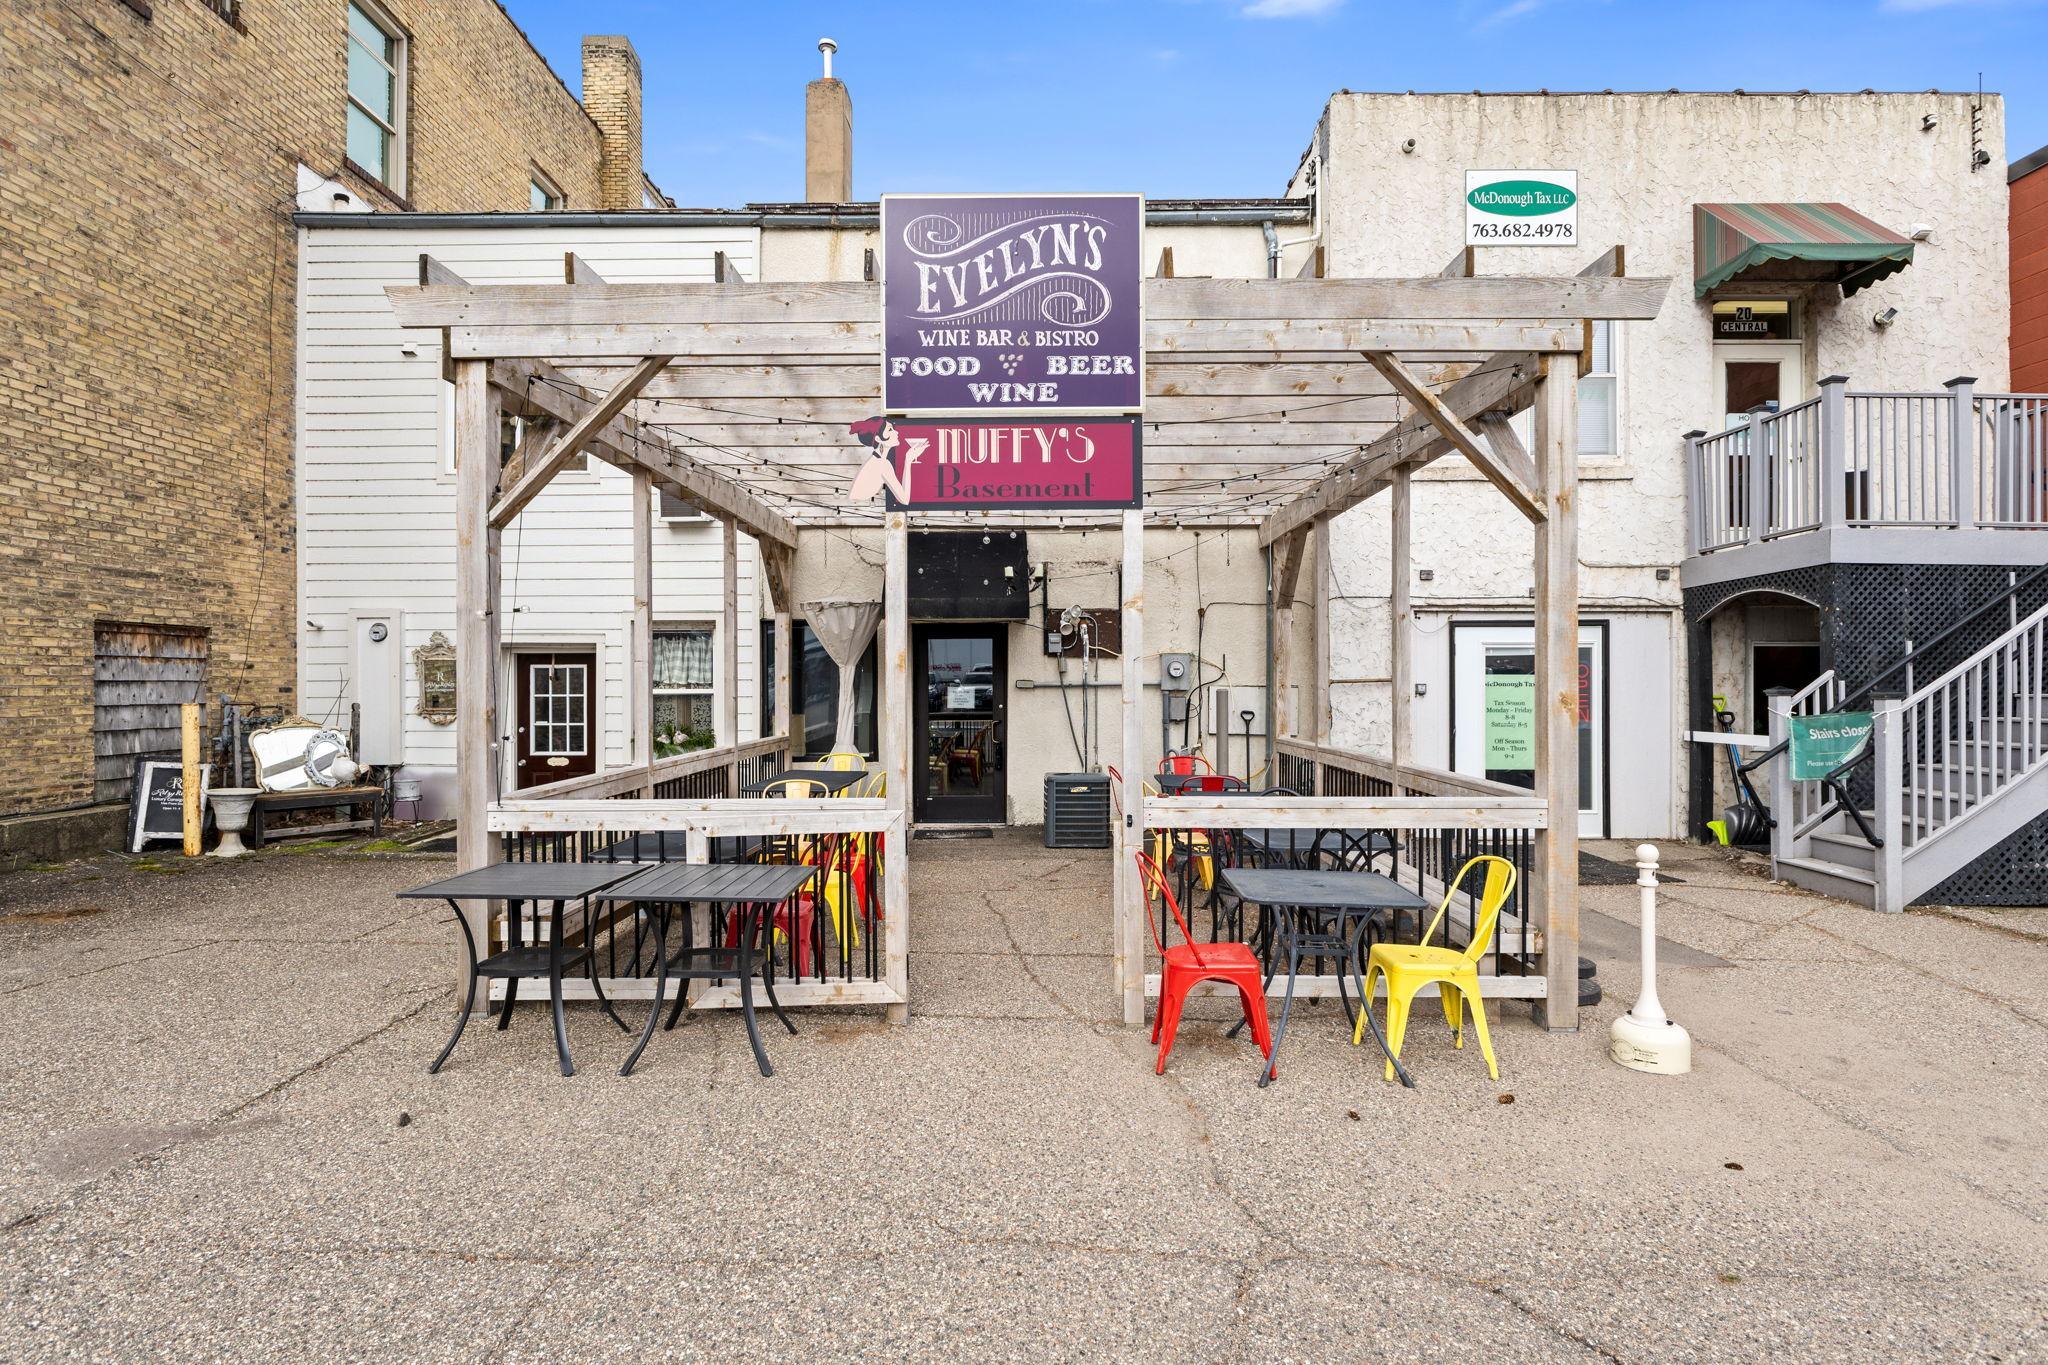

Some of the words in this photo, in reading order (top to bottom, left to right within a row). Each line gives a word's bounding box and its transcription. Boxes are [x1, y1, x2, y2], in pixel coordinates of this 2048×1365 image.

[1474, 191, 1533, 207] McDonough
[1534, 191, 1551, 204] Tax
[1553, 194, 1569, 204] LLC
[1472, 223, 1573, 238] 763.682.4978
[914, 220, 1107, 313] EVELYN'S
[1736, 307, 1752, 320] 20
[1721, 322, 1767, 331] CENTRAL
[918, 329, 971, 348] WINE
[976, 329, 1014, 347] BAR
[1017, 330, 1031, 347] &
[1035, 330, 1099, 347] BISTRO
[890, 356, 981, 378] FOOD
[1046, 355, 1136, 376] BEER
[967, 382, 1059, 403] WINE
[936, 427, 1095, 464] MUFFY'S
[934, 465, 1095, 499] Basement
[1809, 728, 1840, 739] Stairs
[1841, 726, 1869, 737] close
